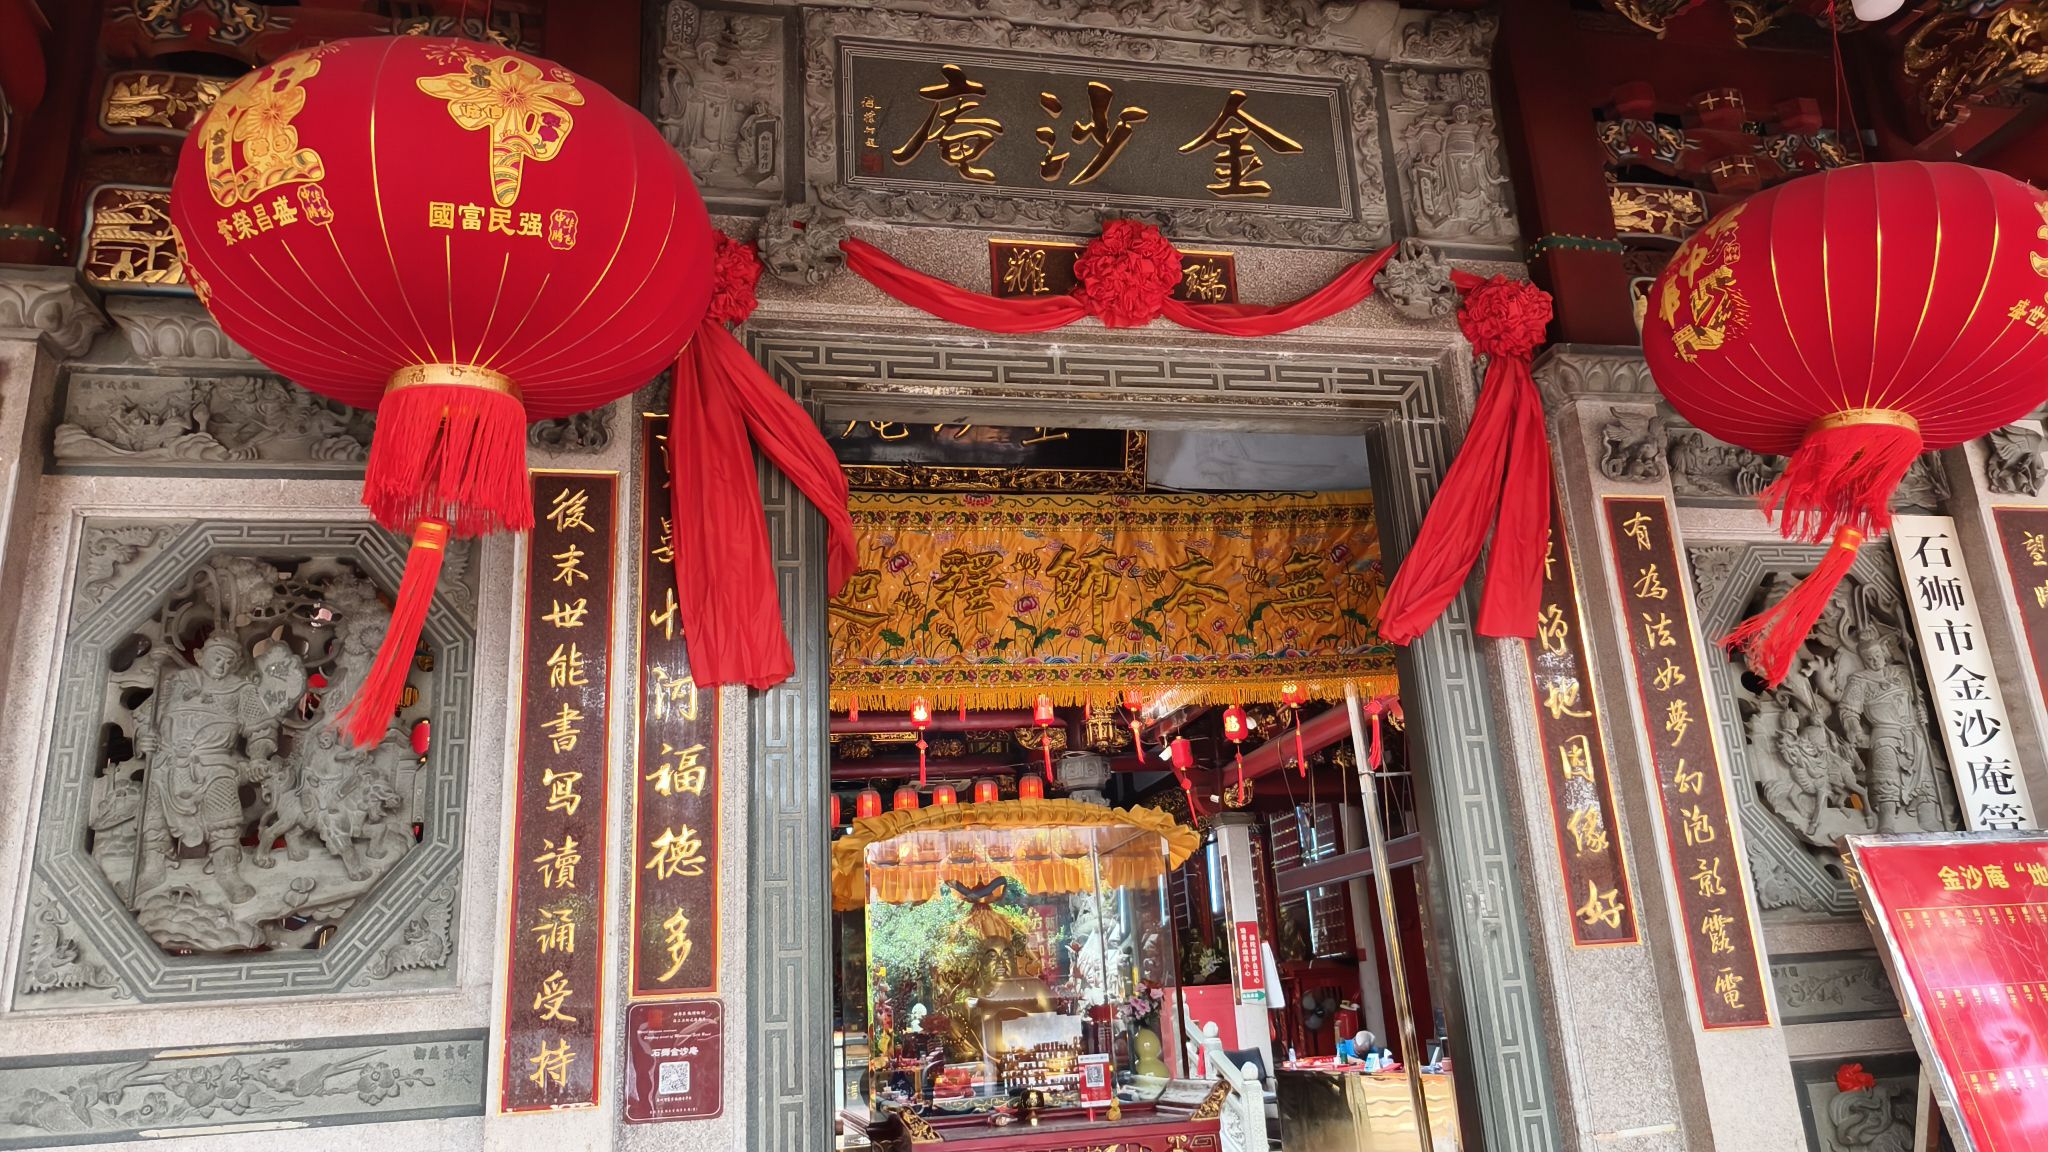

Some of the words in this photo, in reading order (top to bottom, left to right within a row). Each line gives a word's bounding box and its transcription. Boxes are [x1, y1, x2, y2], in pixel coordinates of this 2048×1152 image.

[429, 201, 543, 237] 國富民强
[2008, 299, 2048, 336] 盛世
